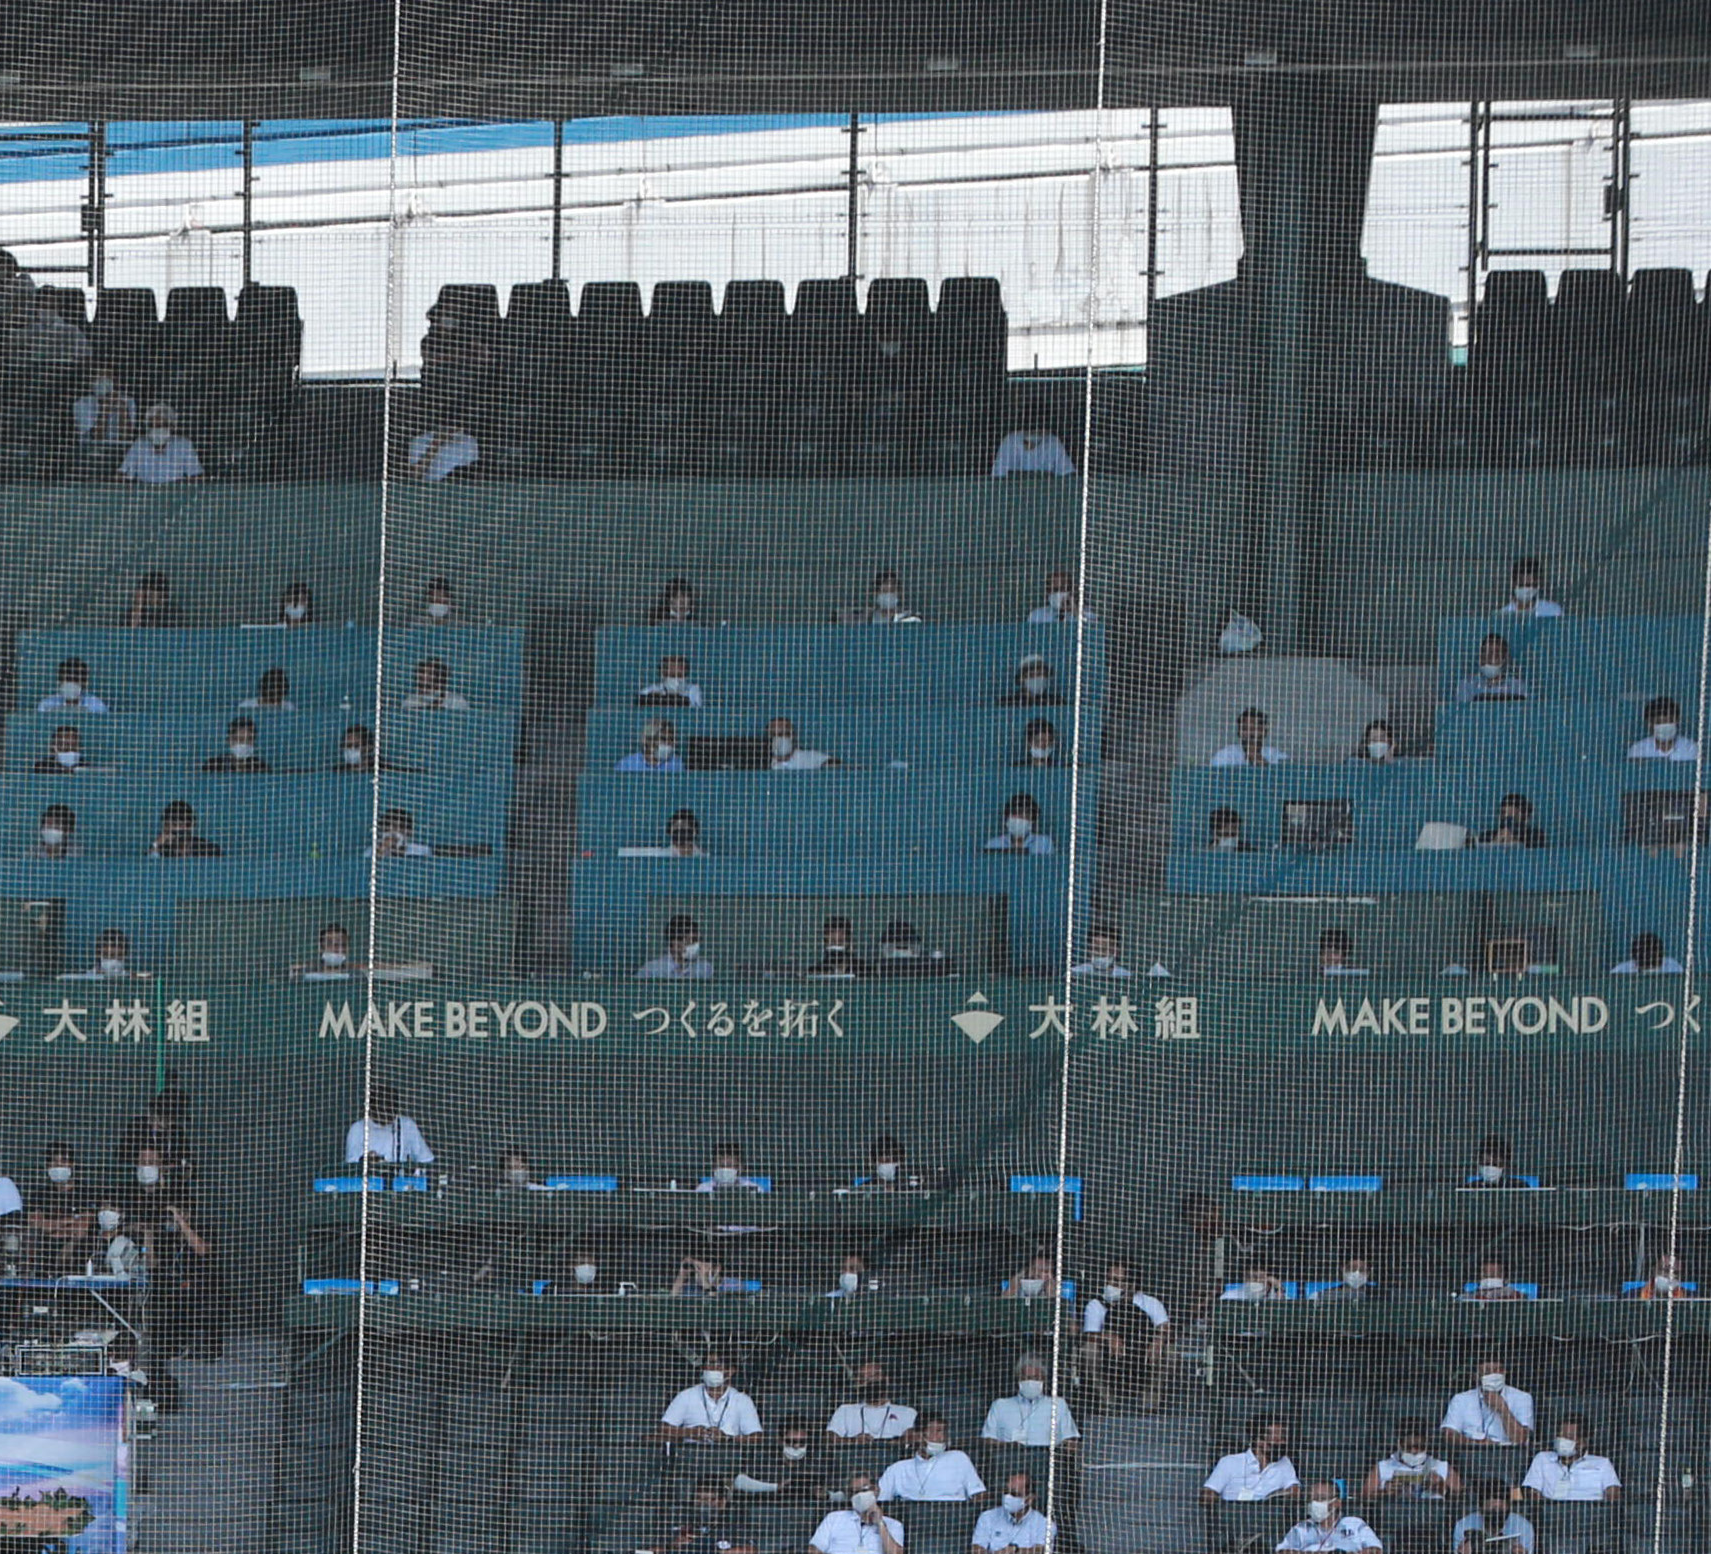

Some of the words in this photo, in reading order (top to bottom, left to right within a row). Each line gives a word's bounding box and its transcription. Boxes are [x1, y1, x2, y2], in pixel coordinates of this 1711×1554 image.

[43, 999, 209, 1043] 大林組
[318, 1001, 435, 1039] MAKE
[446, 1001, 605, 1039] BEYOND
[633, 999, 844, 1041] つくるを拓く
[1028, 996, 1200, 1040] 大林組
[1311, 997, 1429, 1035] MAKE
[1442, 997, 1608, 1035] BEYOND
